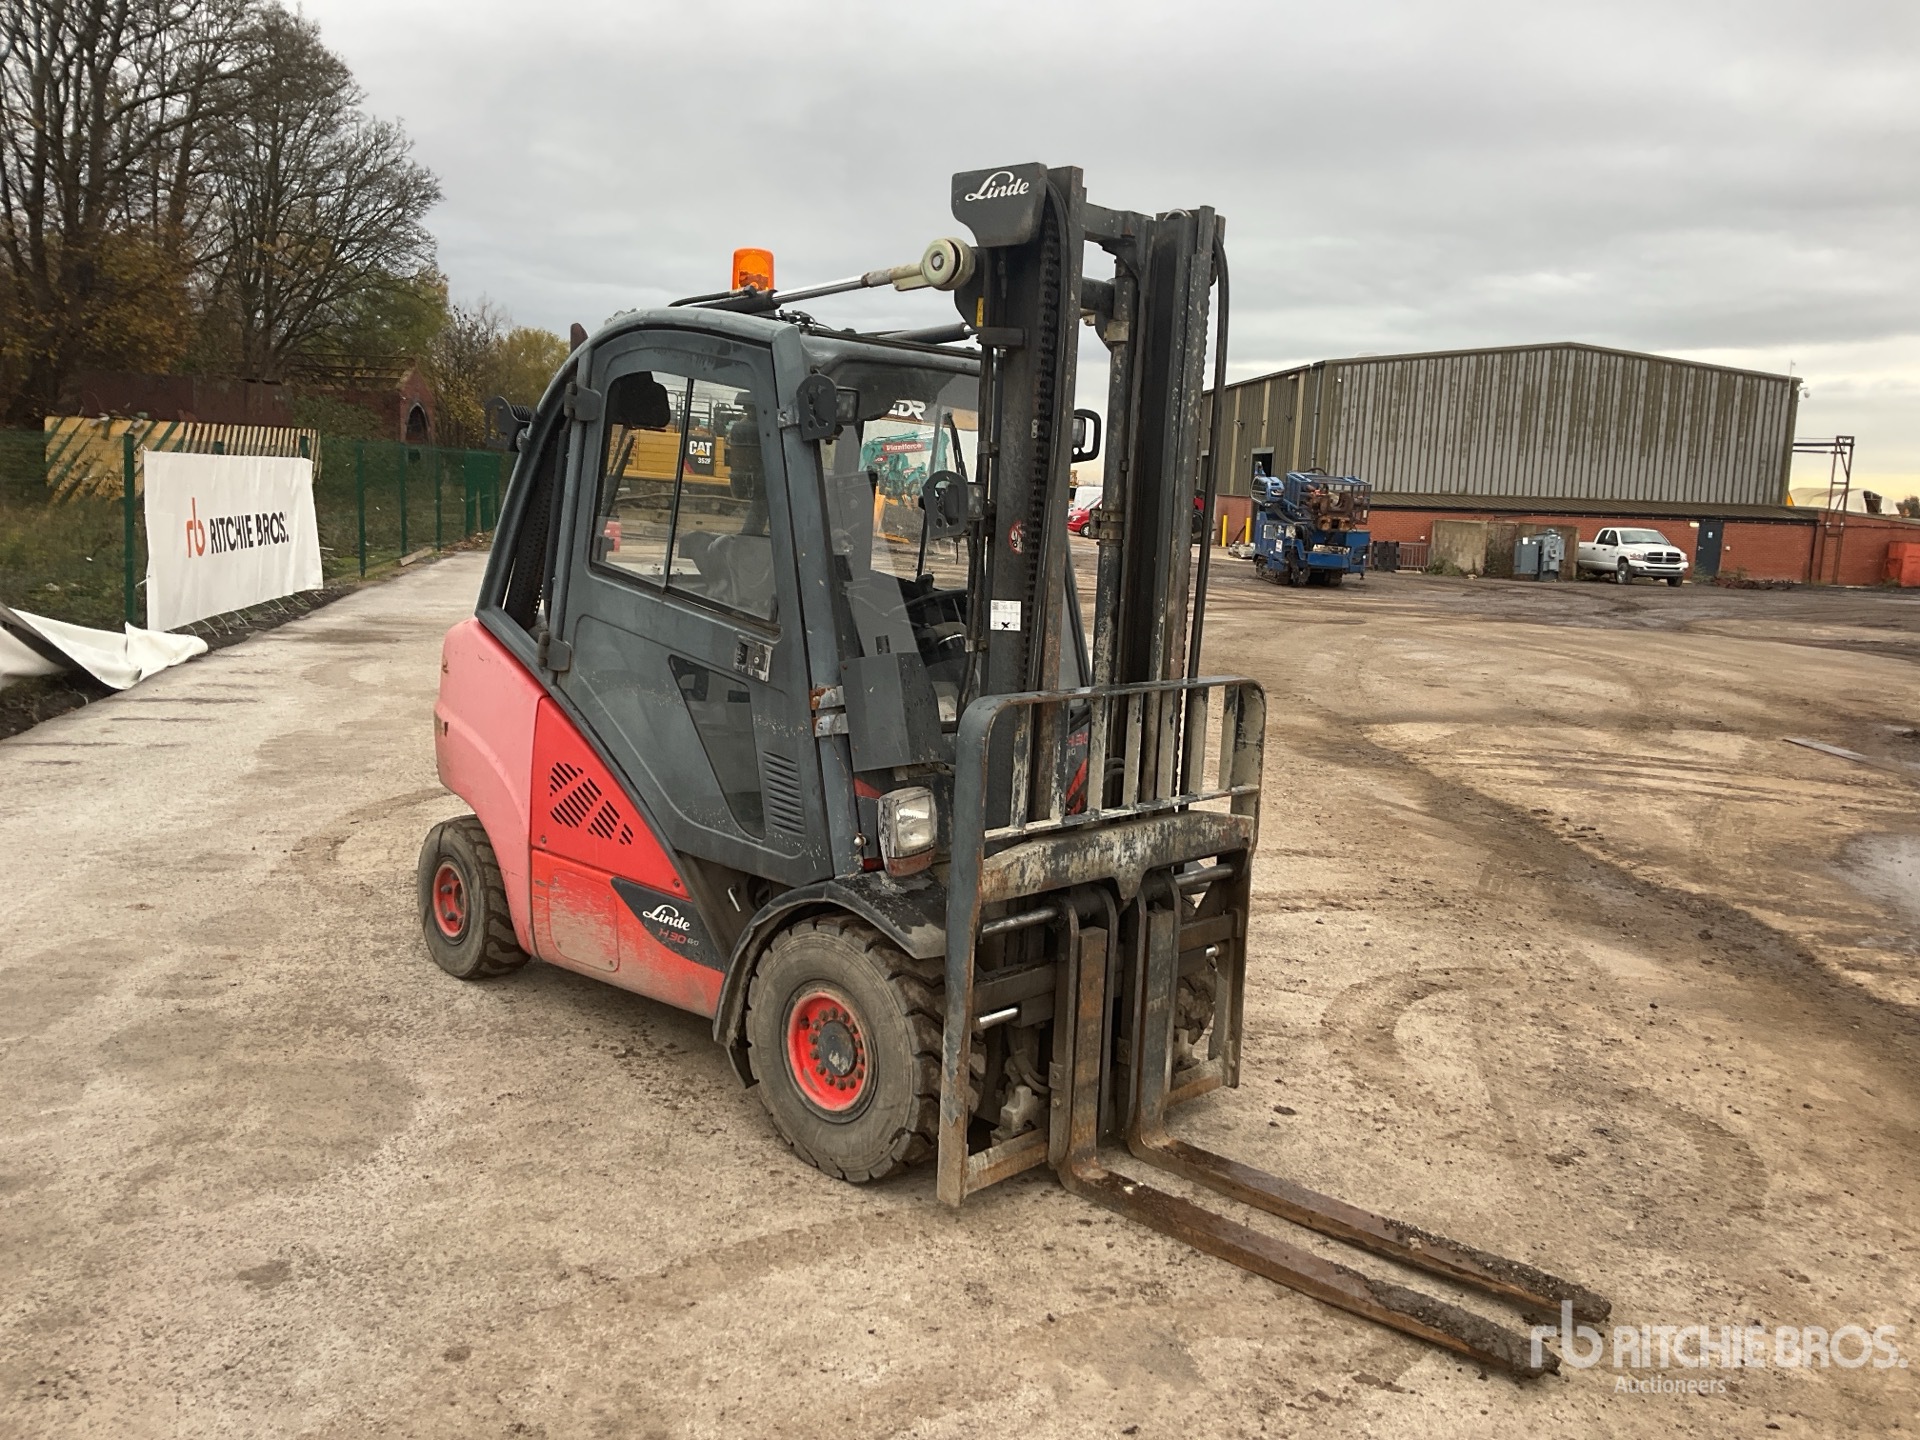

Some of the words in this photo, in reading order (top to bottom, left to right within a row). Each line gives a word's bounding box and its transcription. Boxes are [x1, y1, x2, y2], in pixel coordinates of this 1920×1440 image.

[964, 170, 1030, 202] Linde
[689, 441, 712, 456] CAT
[186, 497, 206, 558] rb
[209, 515, 254, 554] RITCHIE
[255, 511, 289, 547] BROS.
[642, 904, 691, 931] Linde
[659, 928, 686, 945] H30
